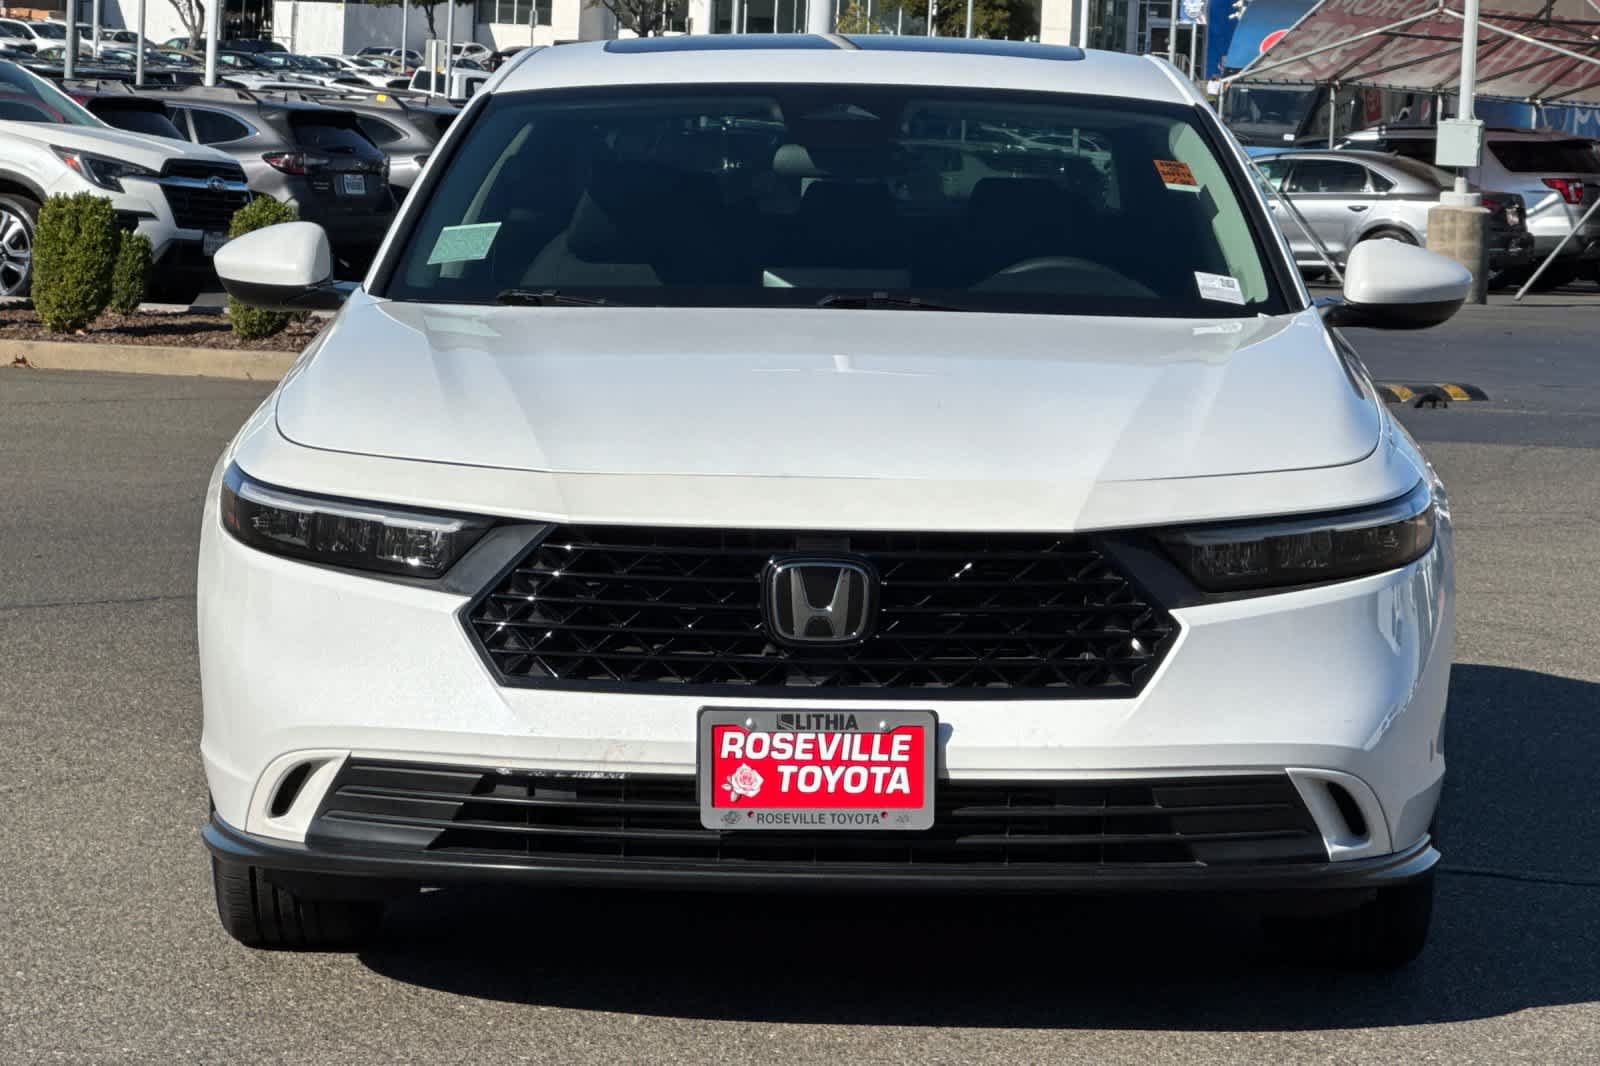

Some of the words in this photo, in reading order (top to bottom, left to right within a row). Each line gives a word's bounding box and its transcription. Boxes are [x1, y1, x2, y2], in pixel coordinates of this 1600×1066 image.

[796, 713, 859, 730] LITHIA
[720, 731, 912, 762] ROSEVILLE
[777, 765, 911, 794] TOYOTA
[756, 812, 826, 825] ROSEVILLE
[831, 813, 880, 825] TOYOTA
